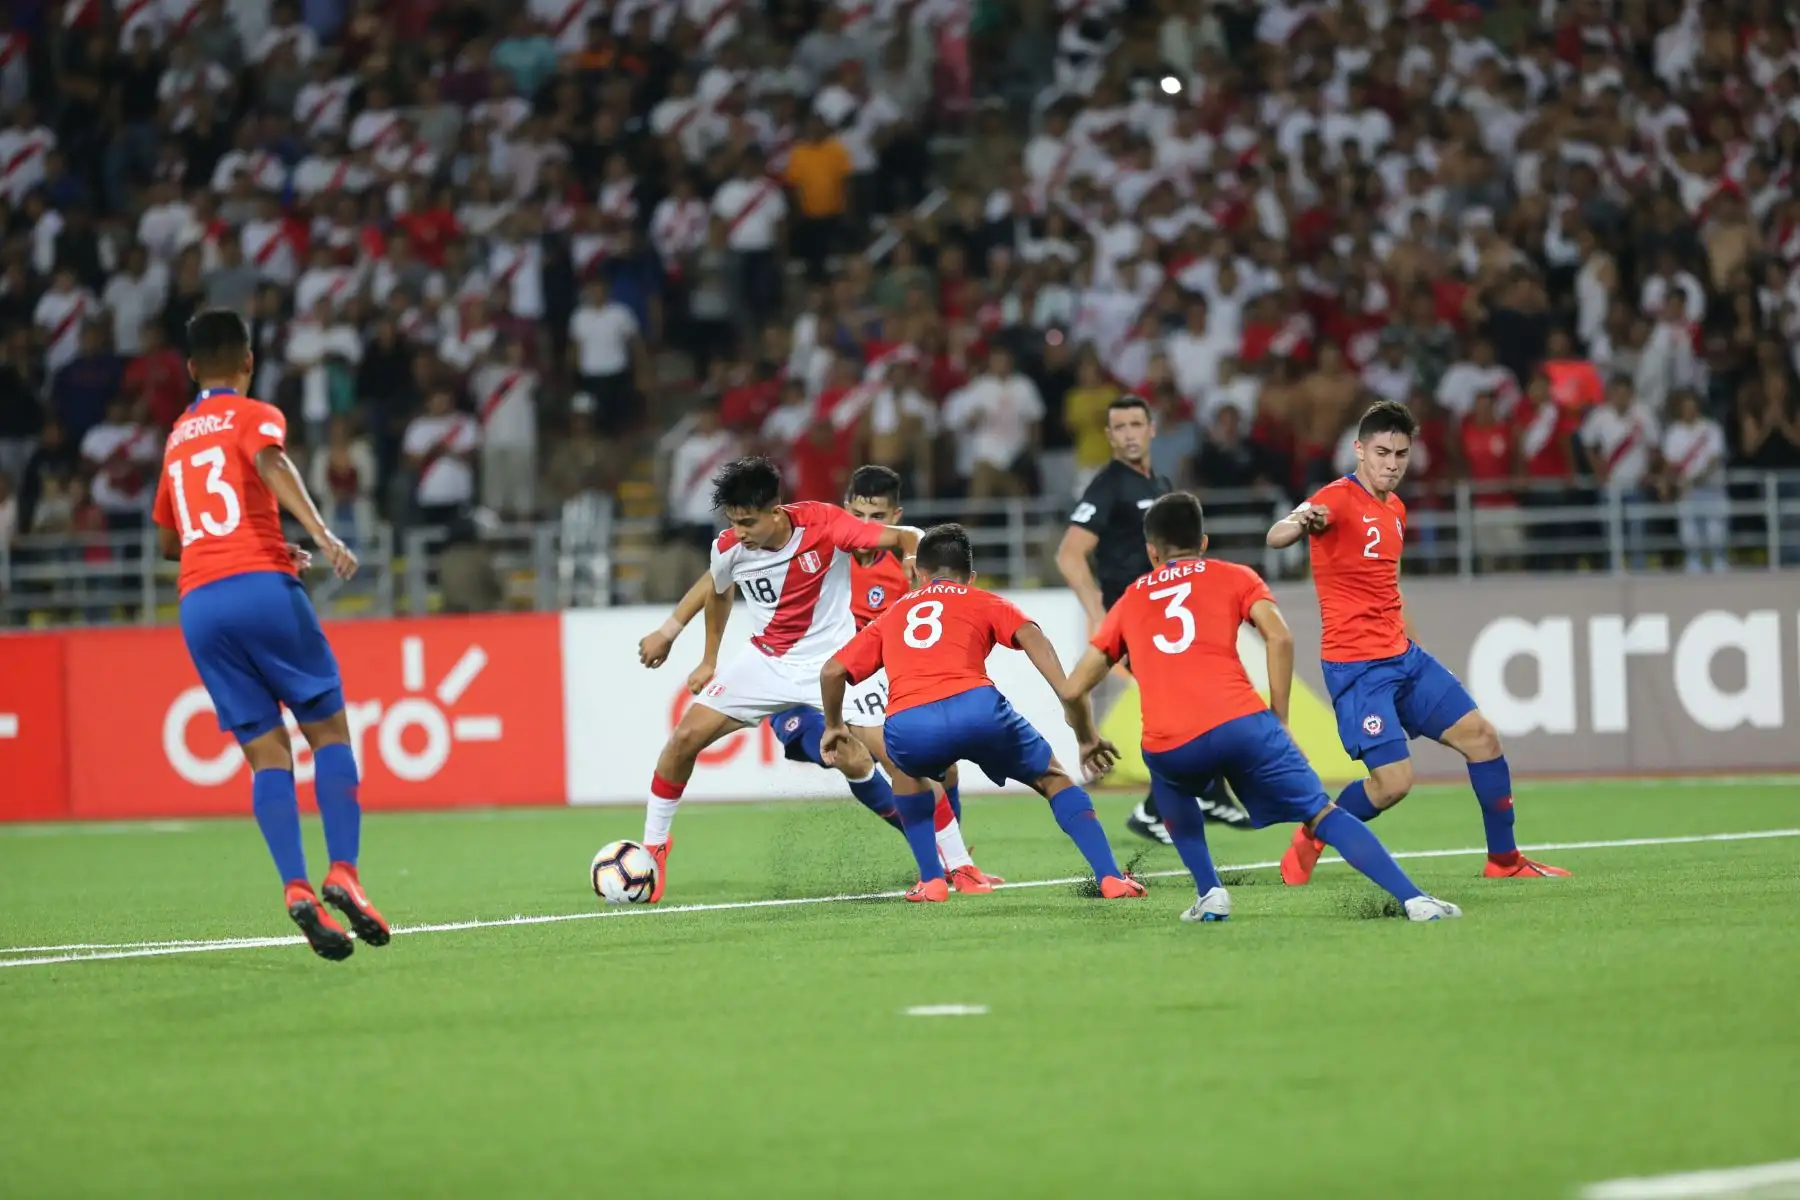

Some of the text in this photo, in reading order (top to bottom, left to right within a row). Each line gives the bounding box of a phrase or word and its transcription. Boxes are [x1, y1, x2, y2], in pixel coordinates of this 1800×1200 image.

[168, 446, 241, 547] 13
[1363, 526, 1381, 558] 2
[745, 577, 777, 603] 18
[1136, 561, 1206, 590] FLORES
[904, 600, 944, 649] 8
[1149, 582, 1196, 654] 3
[1467, 609, 1800, 737] ara
